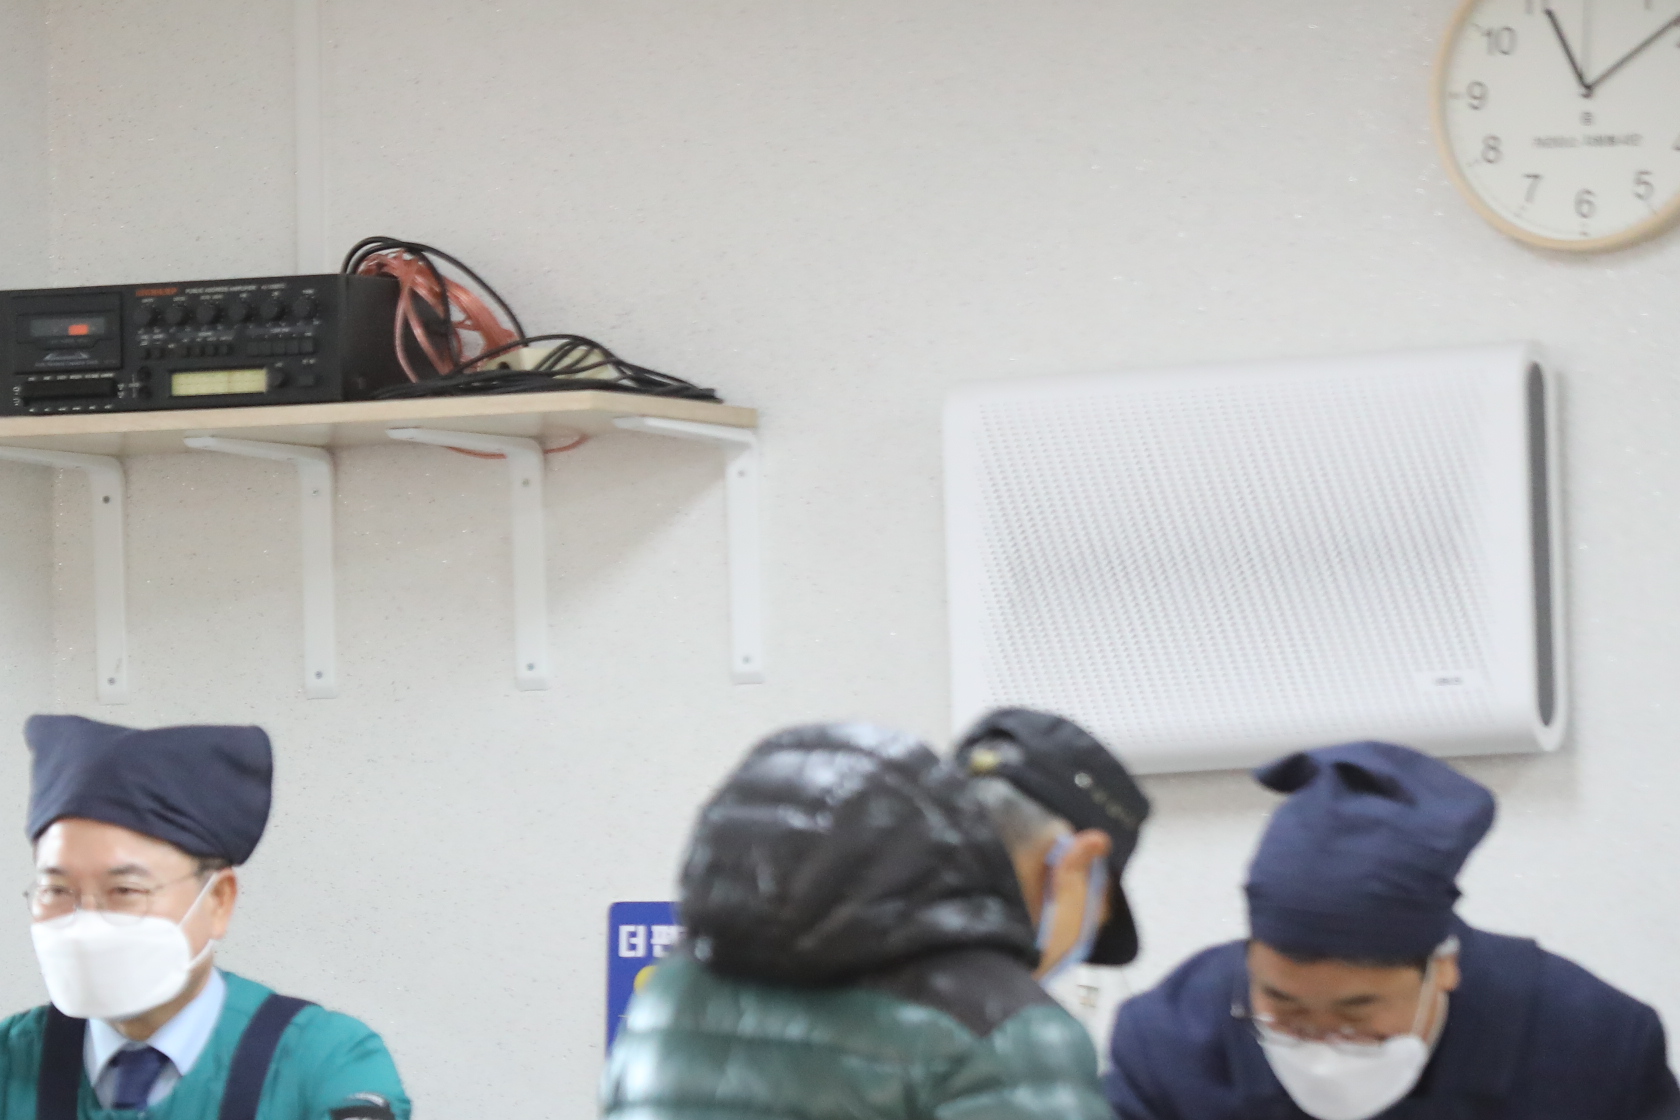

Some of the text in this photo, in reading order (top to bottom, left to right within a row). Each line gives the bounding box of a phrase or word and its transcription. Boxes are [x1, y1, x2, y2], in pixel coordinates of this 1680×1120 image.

[1483, 26, 1517, 56] 10
[1466, 81, 1489, 110] 9
[1481, 135, 1503, 164] 8
[1522, 173, 1543, 203] 7
[1632, 170, 1655, 200] 5
[1574, 189, 1596, 218] 6
